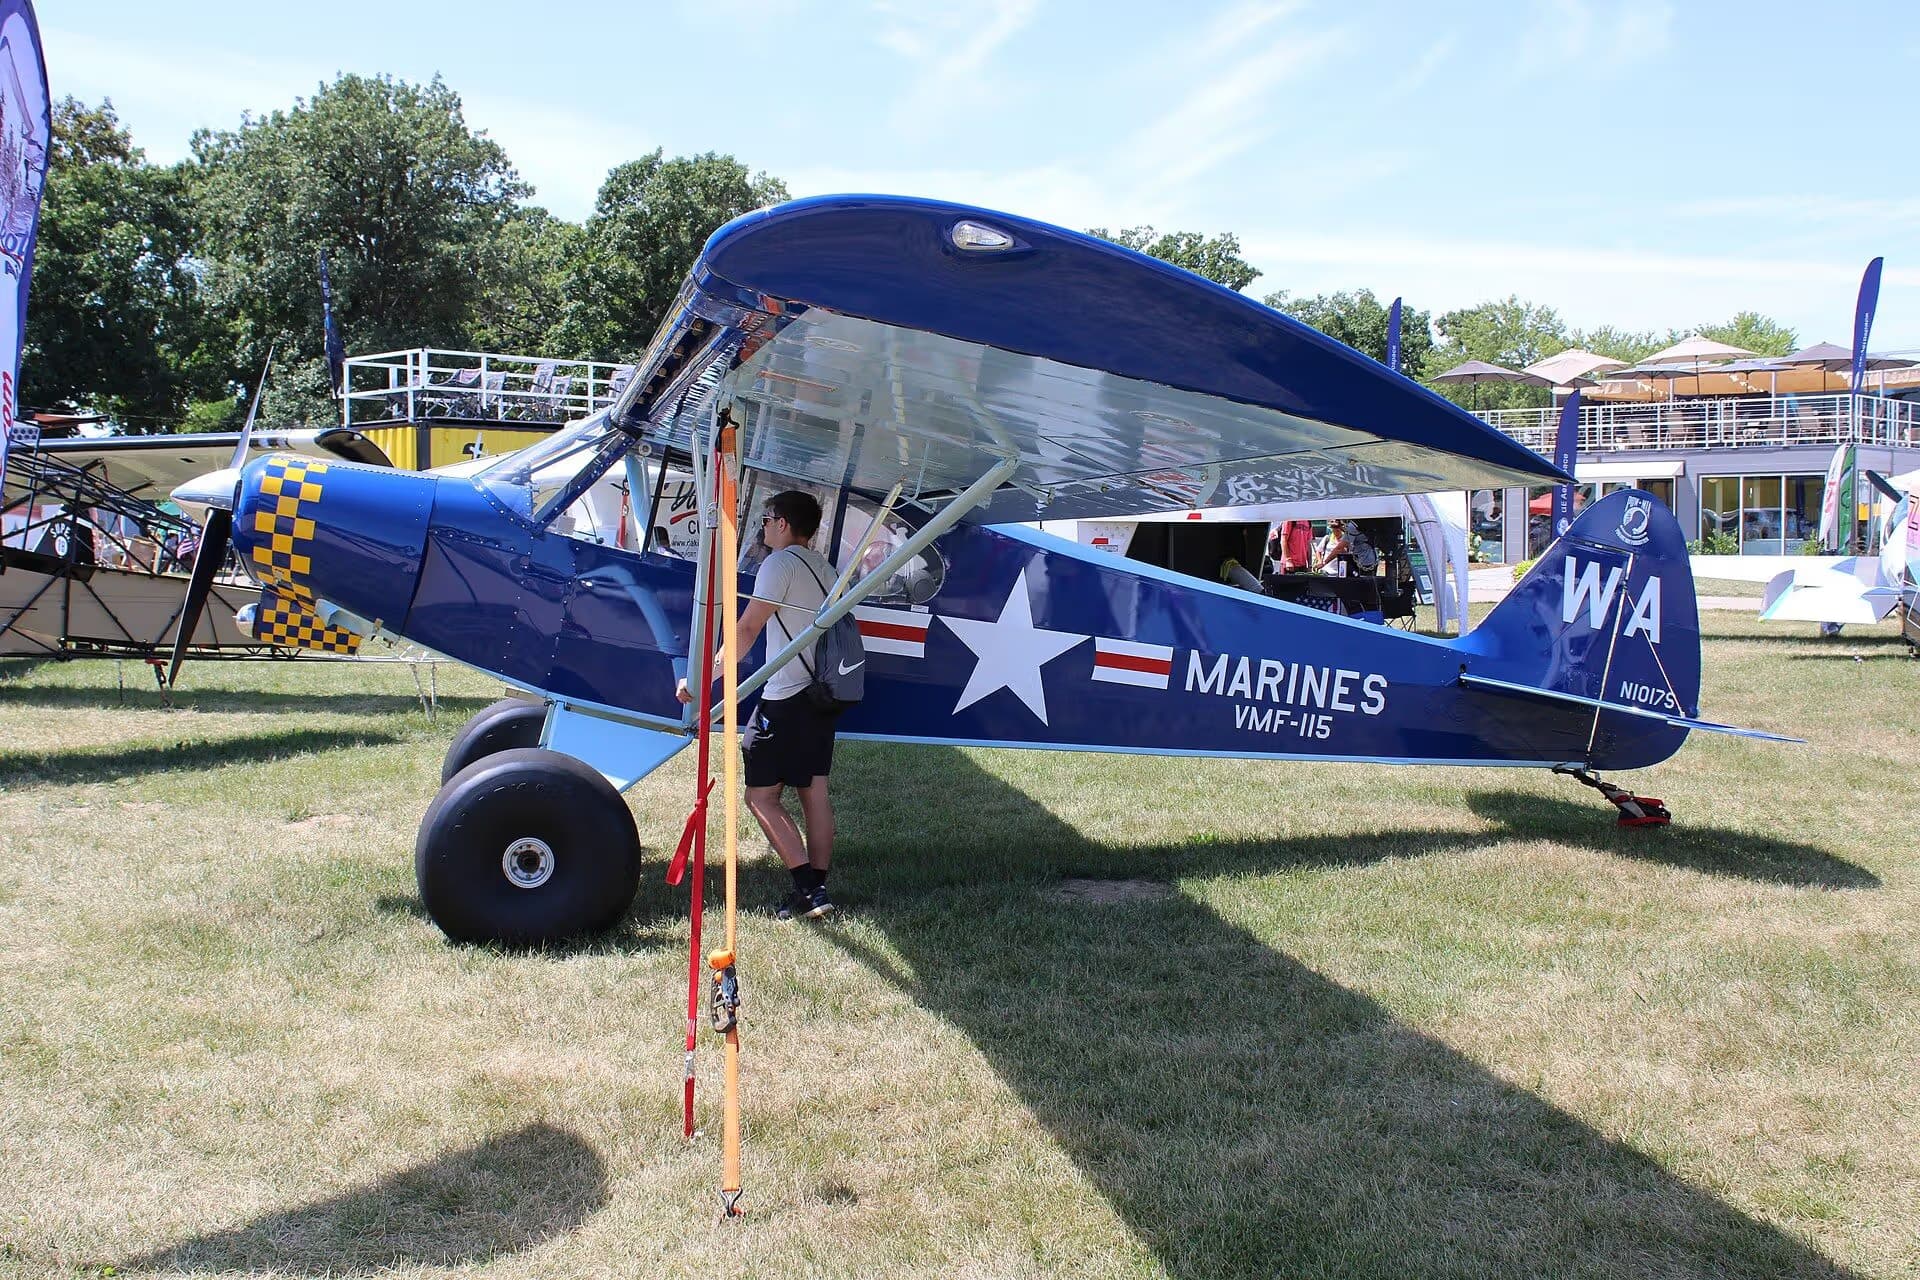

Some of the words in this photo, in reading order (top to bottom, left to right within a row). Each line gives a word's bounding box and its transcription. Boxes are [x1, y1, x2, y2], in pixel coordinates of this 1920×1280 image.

[1184, 649, 1388, 715] MARINES
[1620, 681, 1675, 709] N1017S
[1235, 704, 1333, 739] VMF-115
